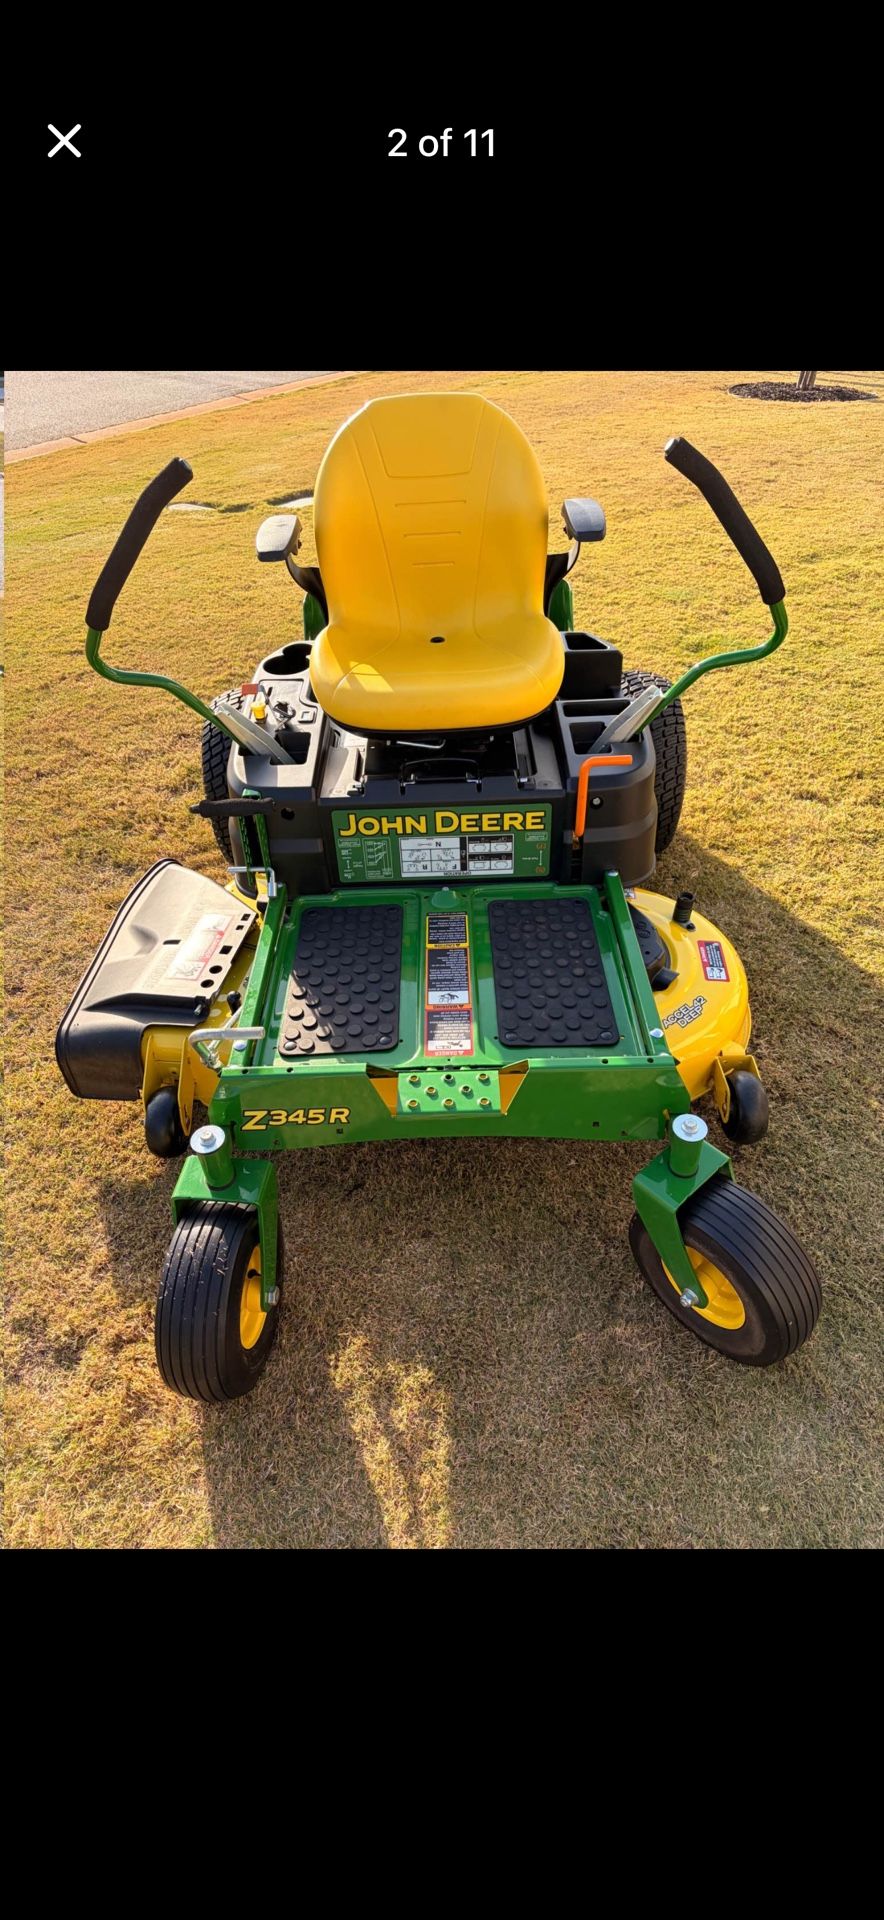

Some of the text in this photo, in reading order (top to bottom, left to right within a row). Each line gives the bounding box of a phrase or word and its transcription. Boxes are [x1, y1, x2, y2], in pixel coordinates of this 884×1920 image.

[339, 811, 546, 837] JOHN DEERE
[677, 1006, 702, 1028] DEEP
